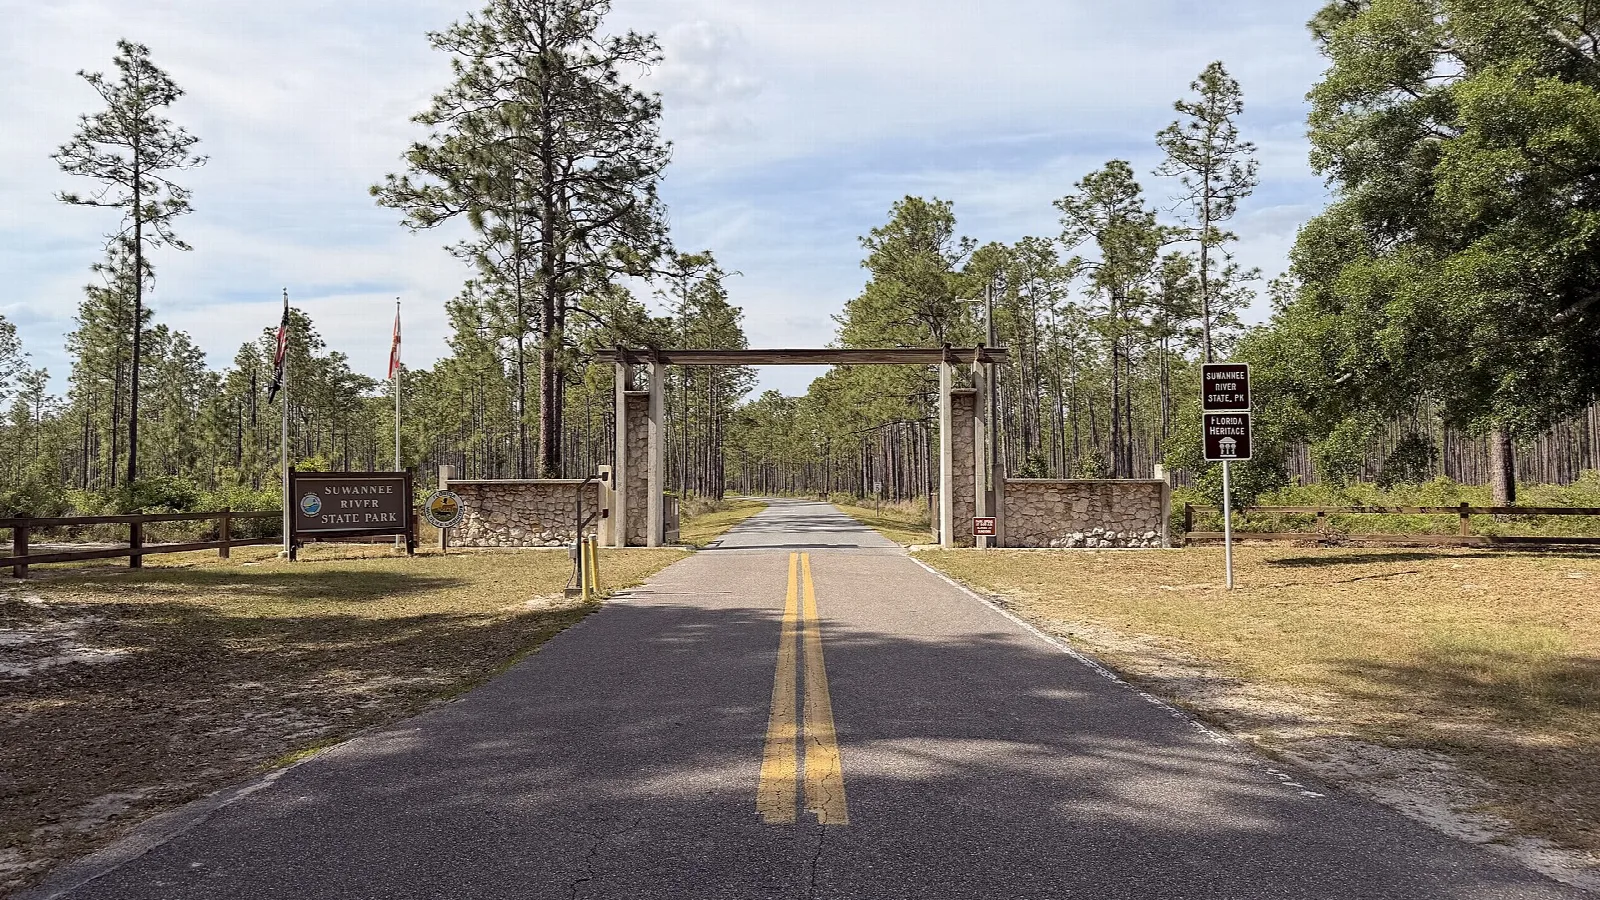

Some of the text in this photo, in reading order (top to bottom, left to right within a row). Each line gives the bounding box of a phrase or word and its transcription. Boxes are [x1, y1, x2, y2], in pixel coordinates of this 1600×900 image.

[1206, 371, 1245, 380] SUWANNEE
[1215, 383, 1236, 391] RIVER
[1234, 394, 1244, 402] PK
[1211, 416, 1243, 425] FLORIDA
[1209, 426, 1245, 435] HERITAGE
[324, 485, 393, 495] SUWANNEE
[340, 499, 379, 509] RIVER
[321, 513, 360, 524] STATE
[365, 512, 397, 522] PARK
